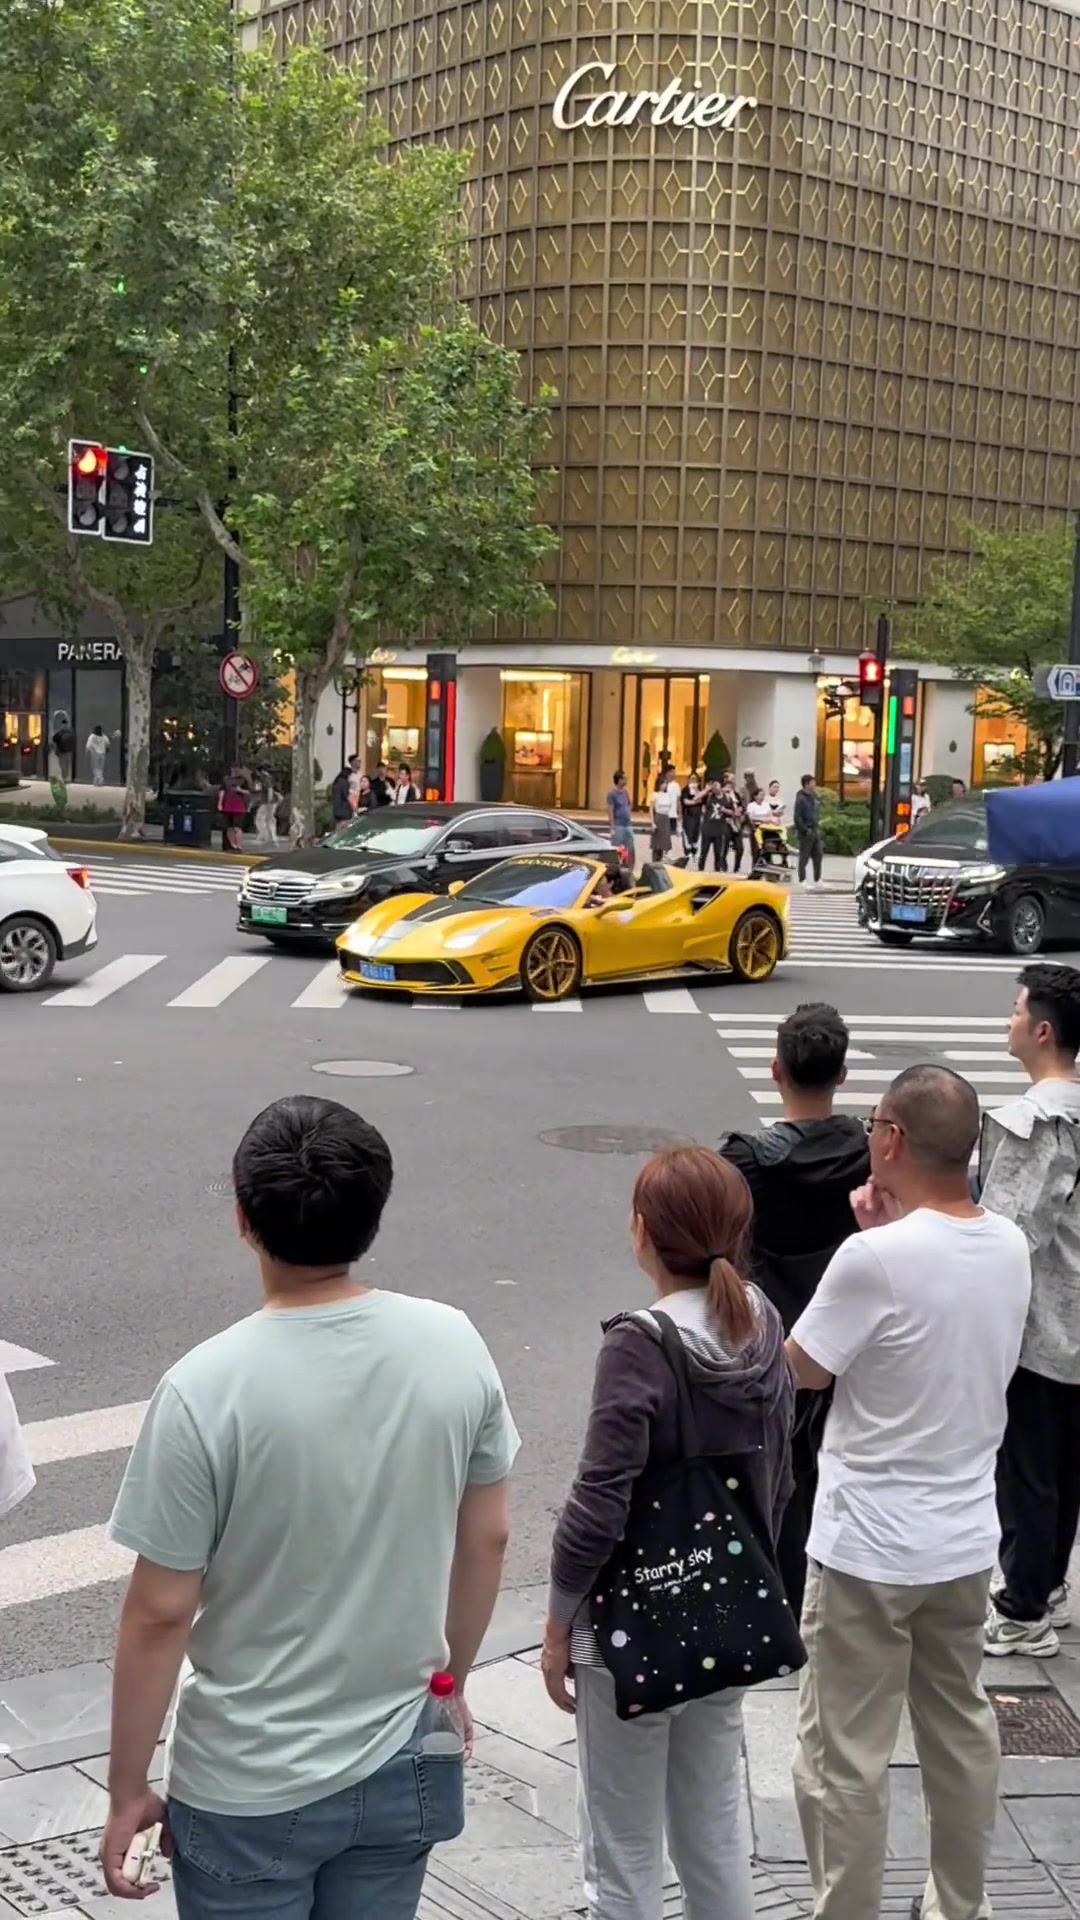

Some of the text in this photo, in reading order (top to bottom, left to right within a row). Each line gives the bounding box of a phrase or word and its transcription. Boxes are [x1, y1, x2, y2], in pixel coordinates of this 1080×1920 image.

[552, 62, 758, 130] Cartier
[634, 1559, 684, 1584] Starry
[688, 1546, 713, 1567] sky
